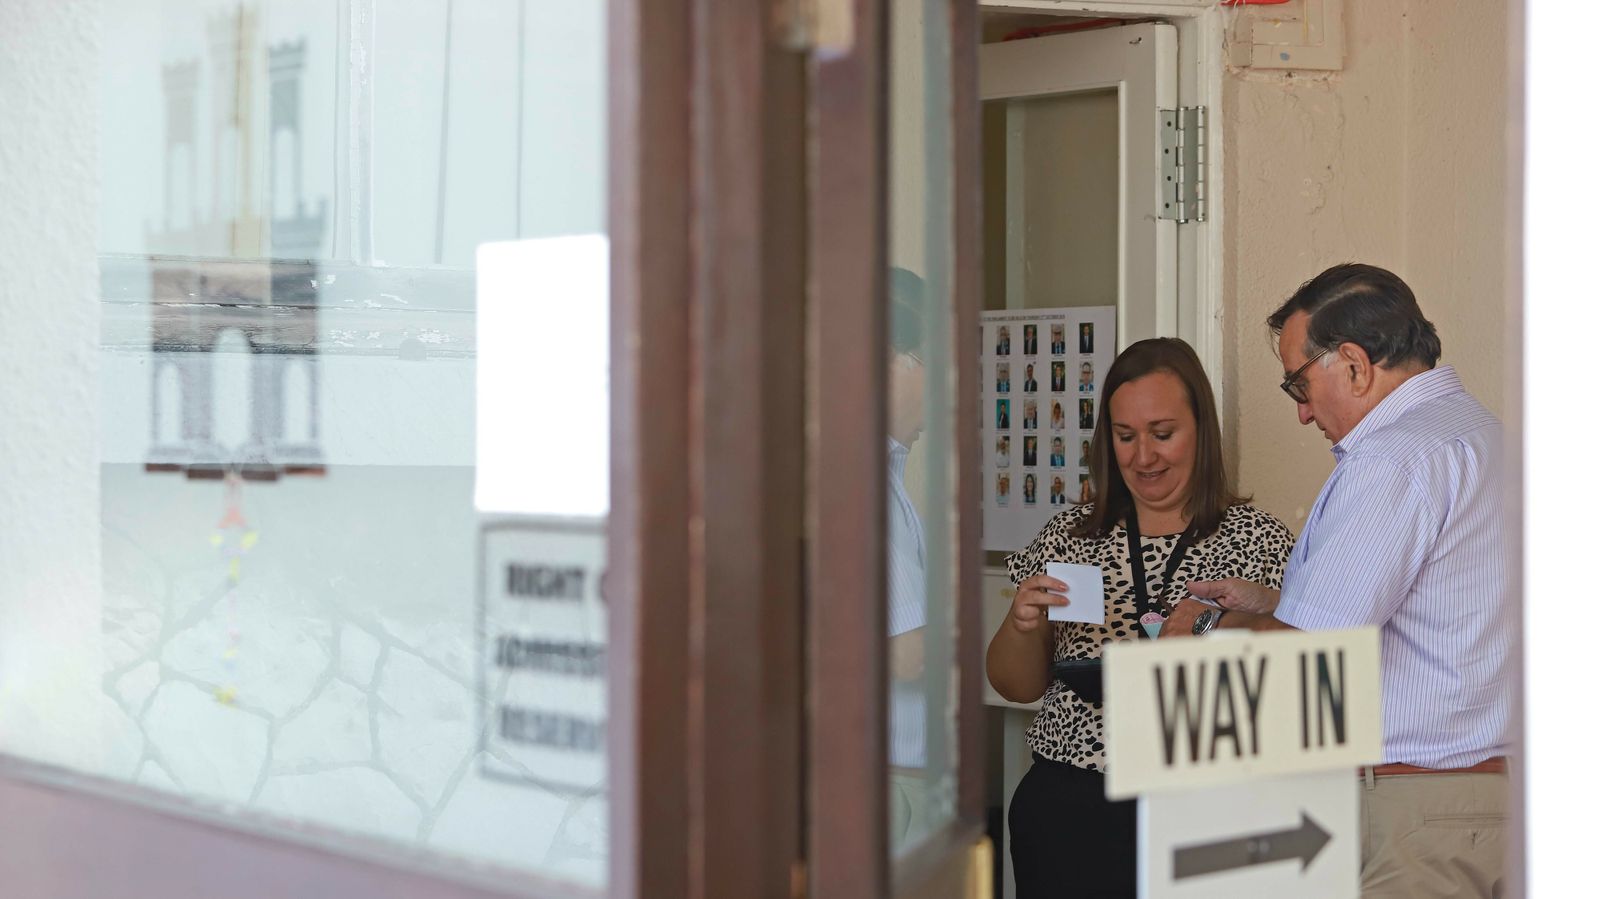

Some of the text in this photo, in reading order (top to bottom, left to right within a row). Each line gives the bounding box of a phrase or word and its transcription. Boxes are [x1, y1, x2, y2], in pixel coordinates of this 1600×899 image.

[507, 563, 585, 601] RIGHT
[1151, 648, 1346, 767] WAY IN
